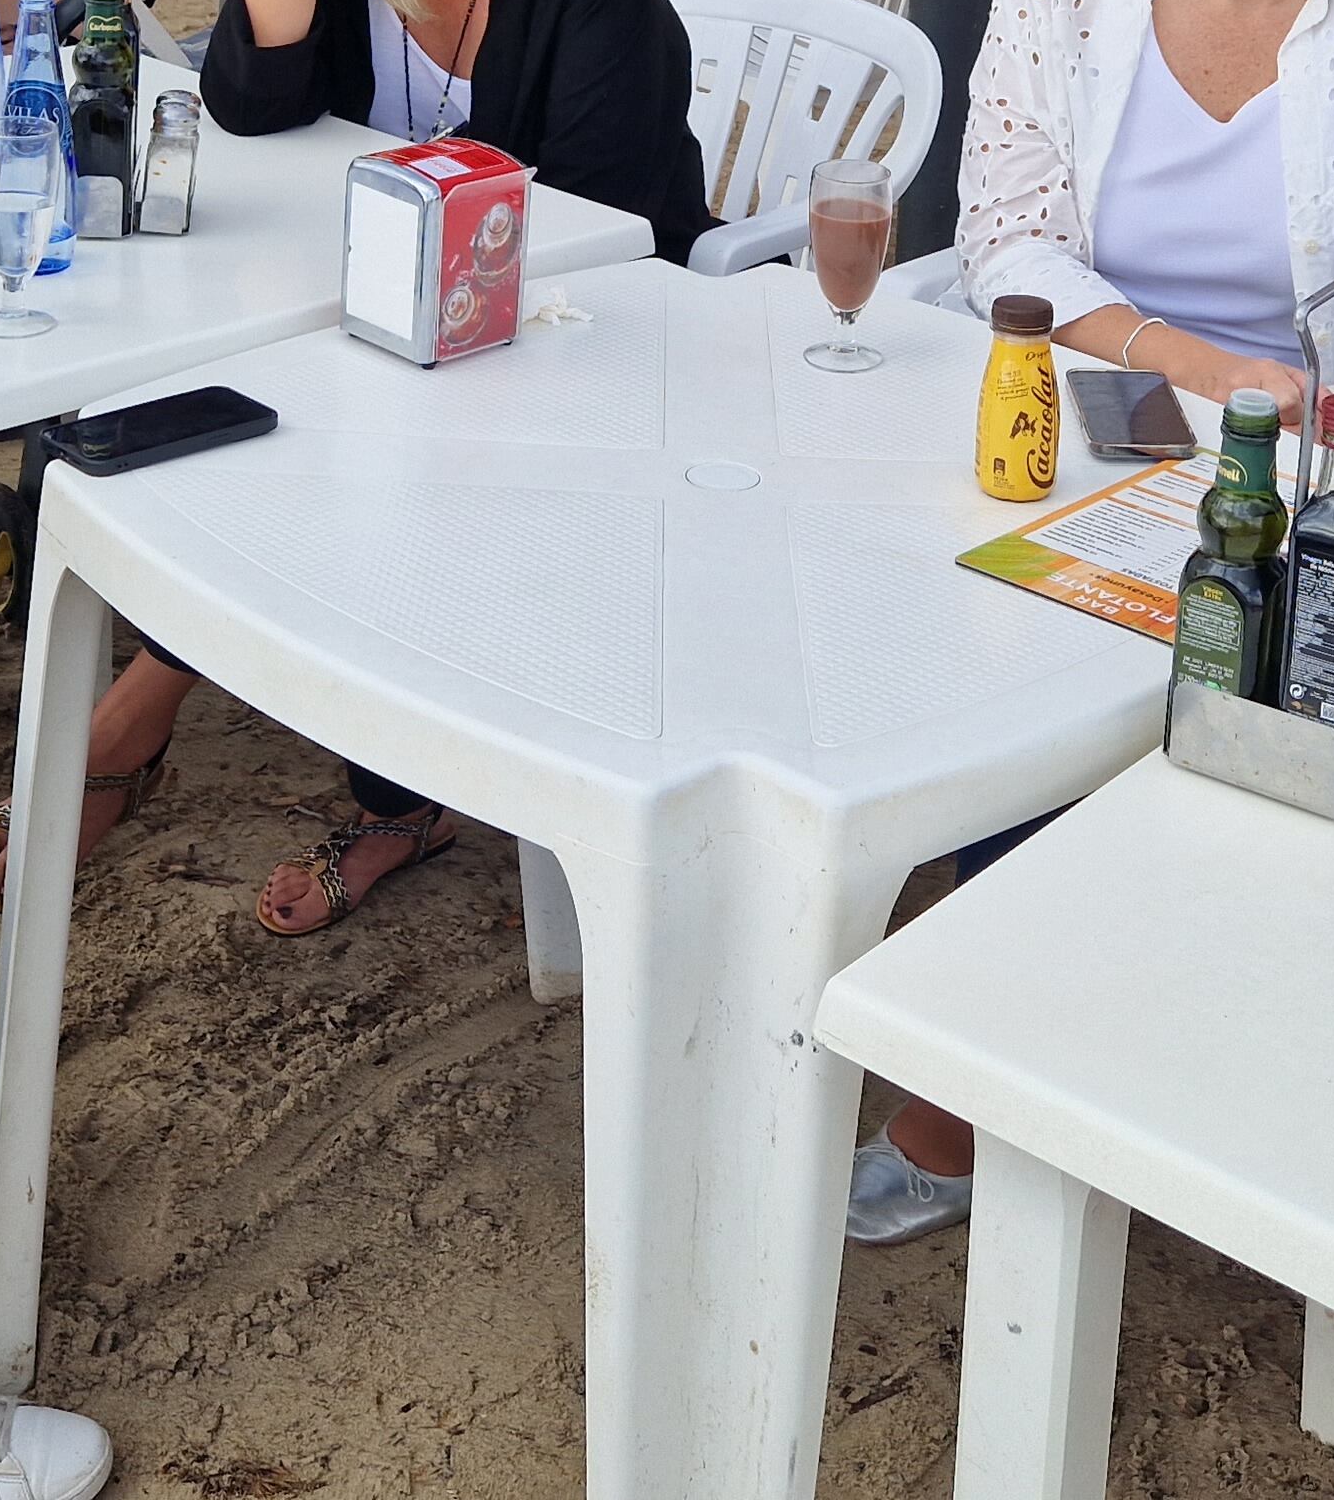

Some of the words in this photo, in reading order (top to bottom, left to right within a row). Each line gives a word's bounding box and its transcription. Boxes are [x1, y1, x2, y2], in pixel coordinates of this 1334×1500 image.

[1026, 362, 1054, 489] Cacaolat
[1046, 571, 1177, 625] FLOTANTE
[1074, 594, 1120, 616] BAR
